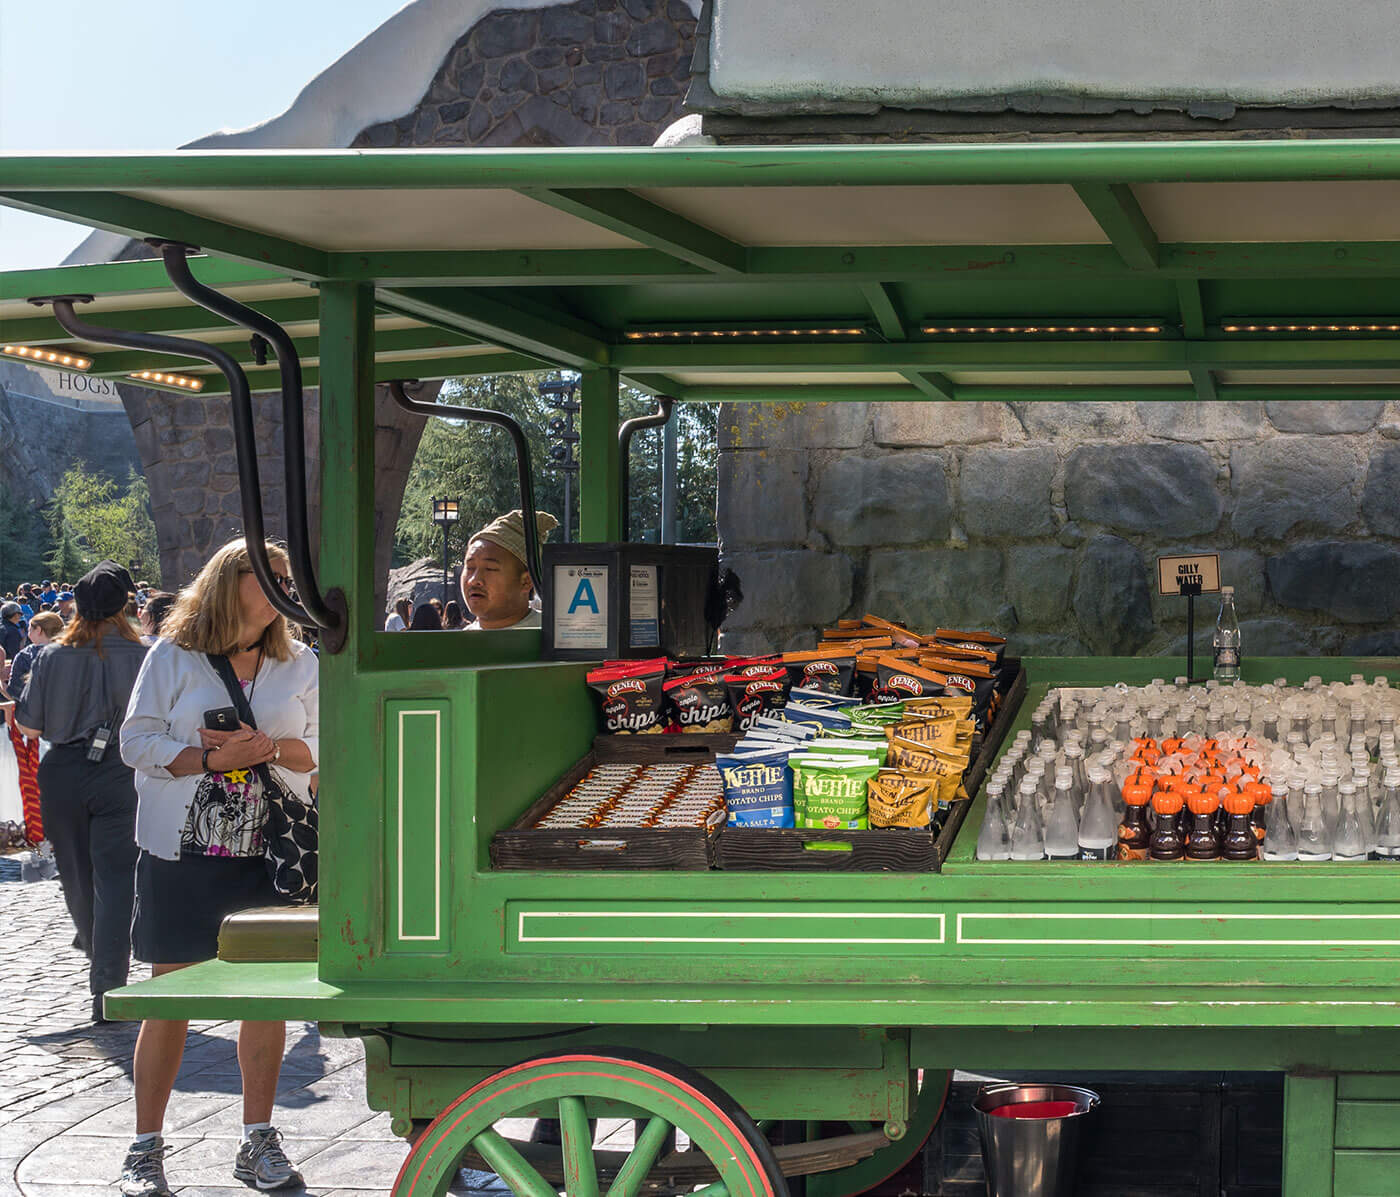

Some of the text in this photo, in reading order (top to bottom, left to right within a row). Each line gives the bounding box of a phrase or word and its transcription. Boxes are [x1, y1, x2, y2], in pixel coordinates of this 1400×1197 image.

[1178, 563, 1200, 574] GILLY
[1176, 574, 1203, 585] WATER
[567, 578, 600, 614] A
[806, 662, 836, 674] SENECA
[611, 680, 643, 695] SENECA
[749, 681, 779, 693] SENECA
[891, 676, 919, 694] SENECA
[605, 703, 626, 714] apple
[741, 699, 761, 712] apple
[680, 703, 730, 724] chips
[607, 711, 659, 730] chips
[723, 764, 784, 789] KETTLE
[741, 787, 765, 795] BRAND
[805, 774, 864, 798] KETTLE
[758, 793, 784, 803] CHIPS
[807, 806, 861, 815] OTATO CHIPS
